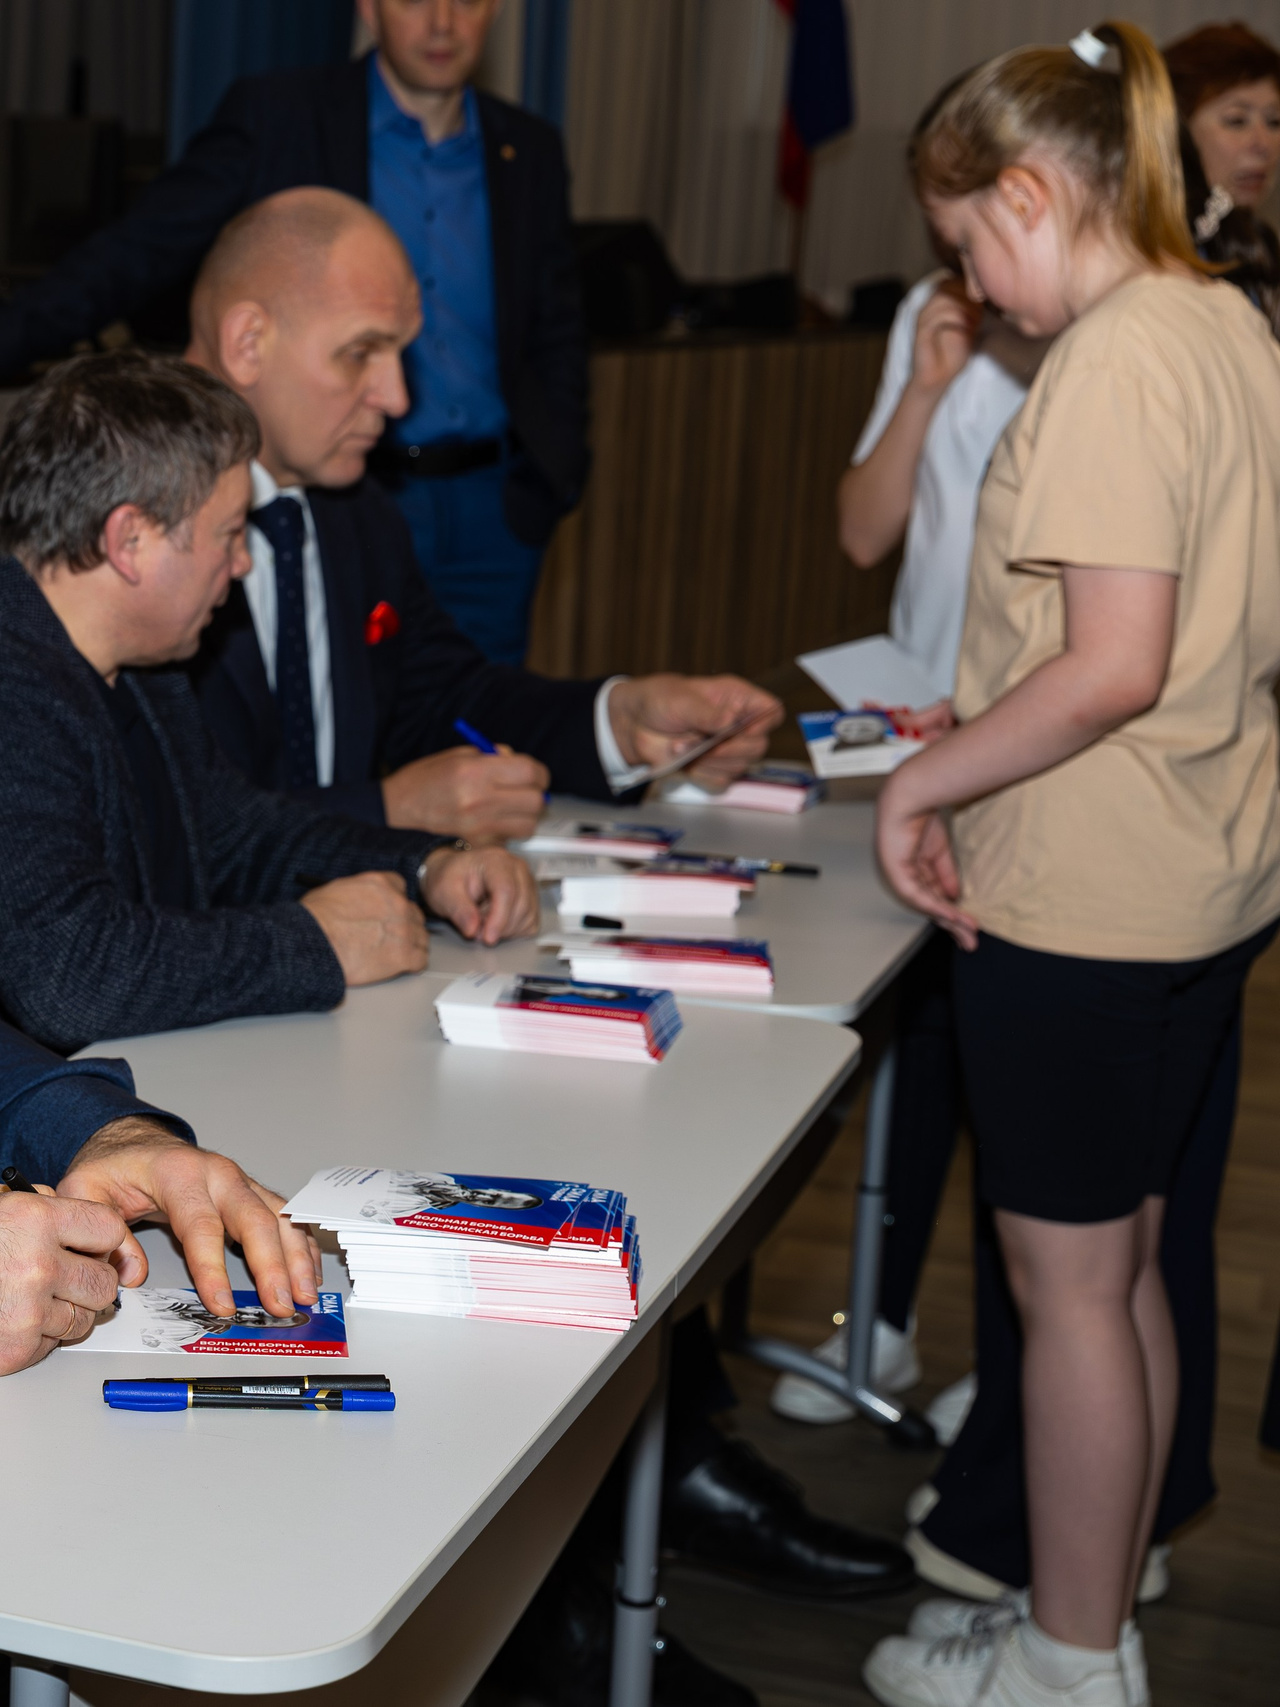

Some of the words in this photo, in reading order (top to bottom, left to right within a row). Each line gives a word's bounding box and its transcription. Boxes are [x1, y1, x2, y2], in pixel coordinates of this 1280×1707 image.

[403, 1219, 499, 1236] ГРЕКО-РИМСКАЯ
[499, 1231, 544, 1242] БОРЬБА
[414, 1214, 468, 1226] ВОЛЬНАЯ
[470, 1221, 514, 1232] БОРЬБА
[322, 1294, 339, 1314] СИЛА
[192, 1346, 293, 1354] ГРЕКО-РИМСКАЯ
